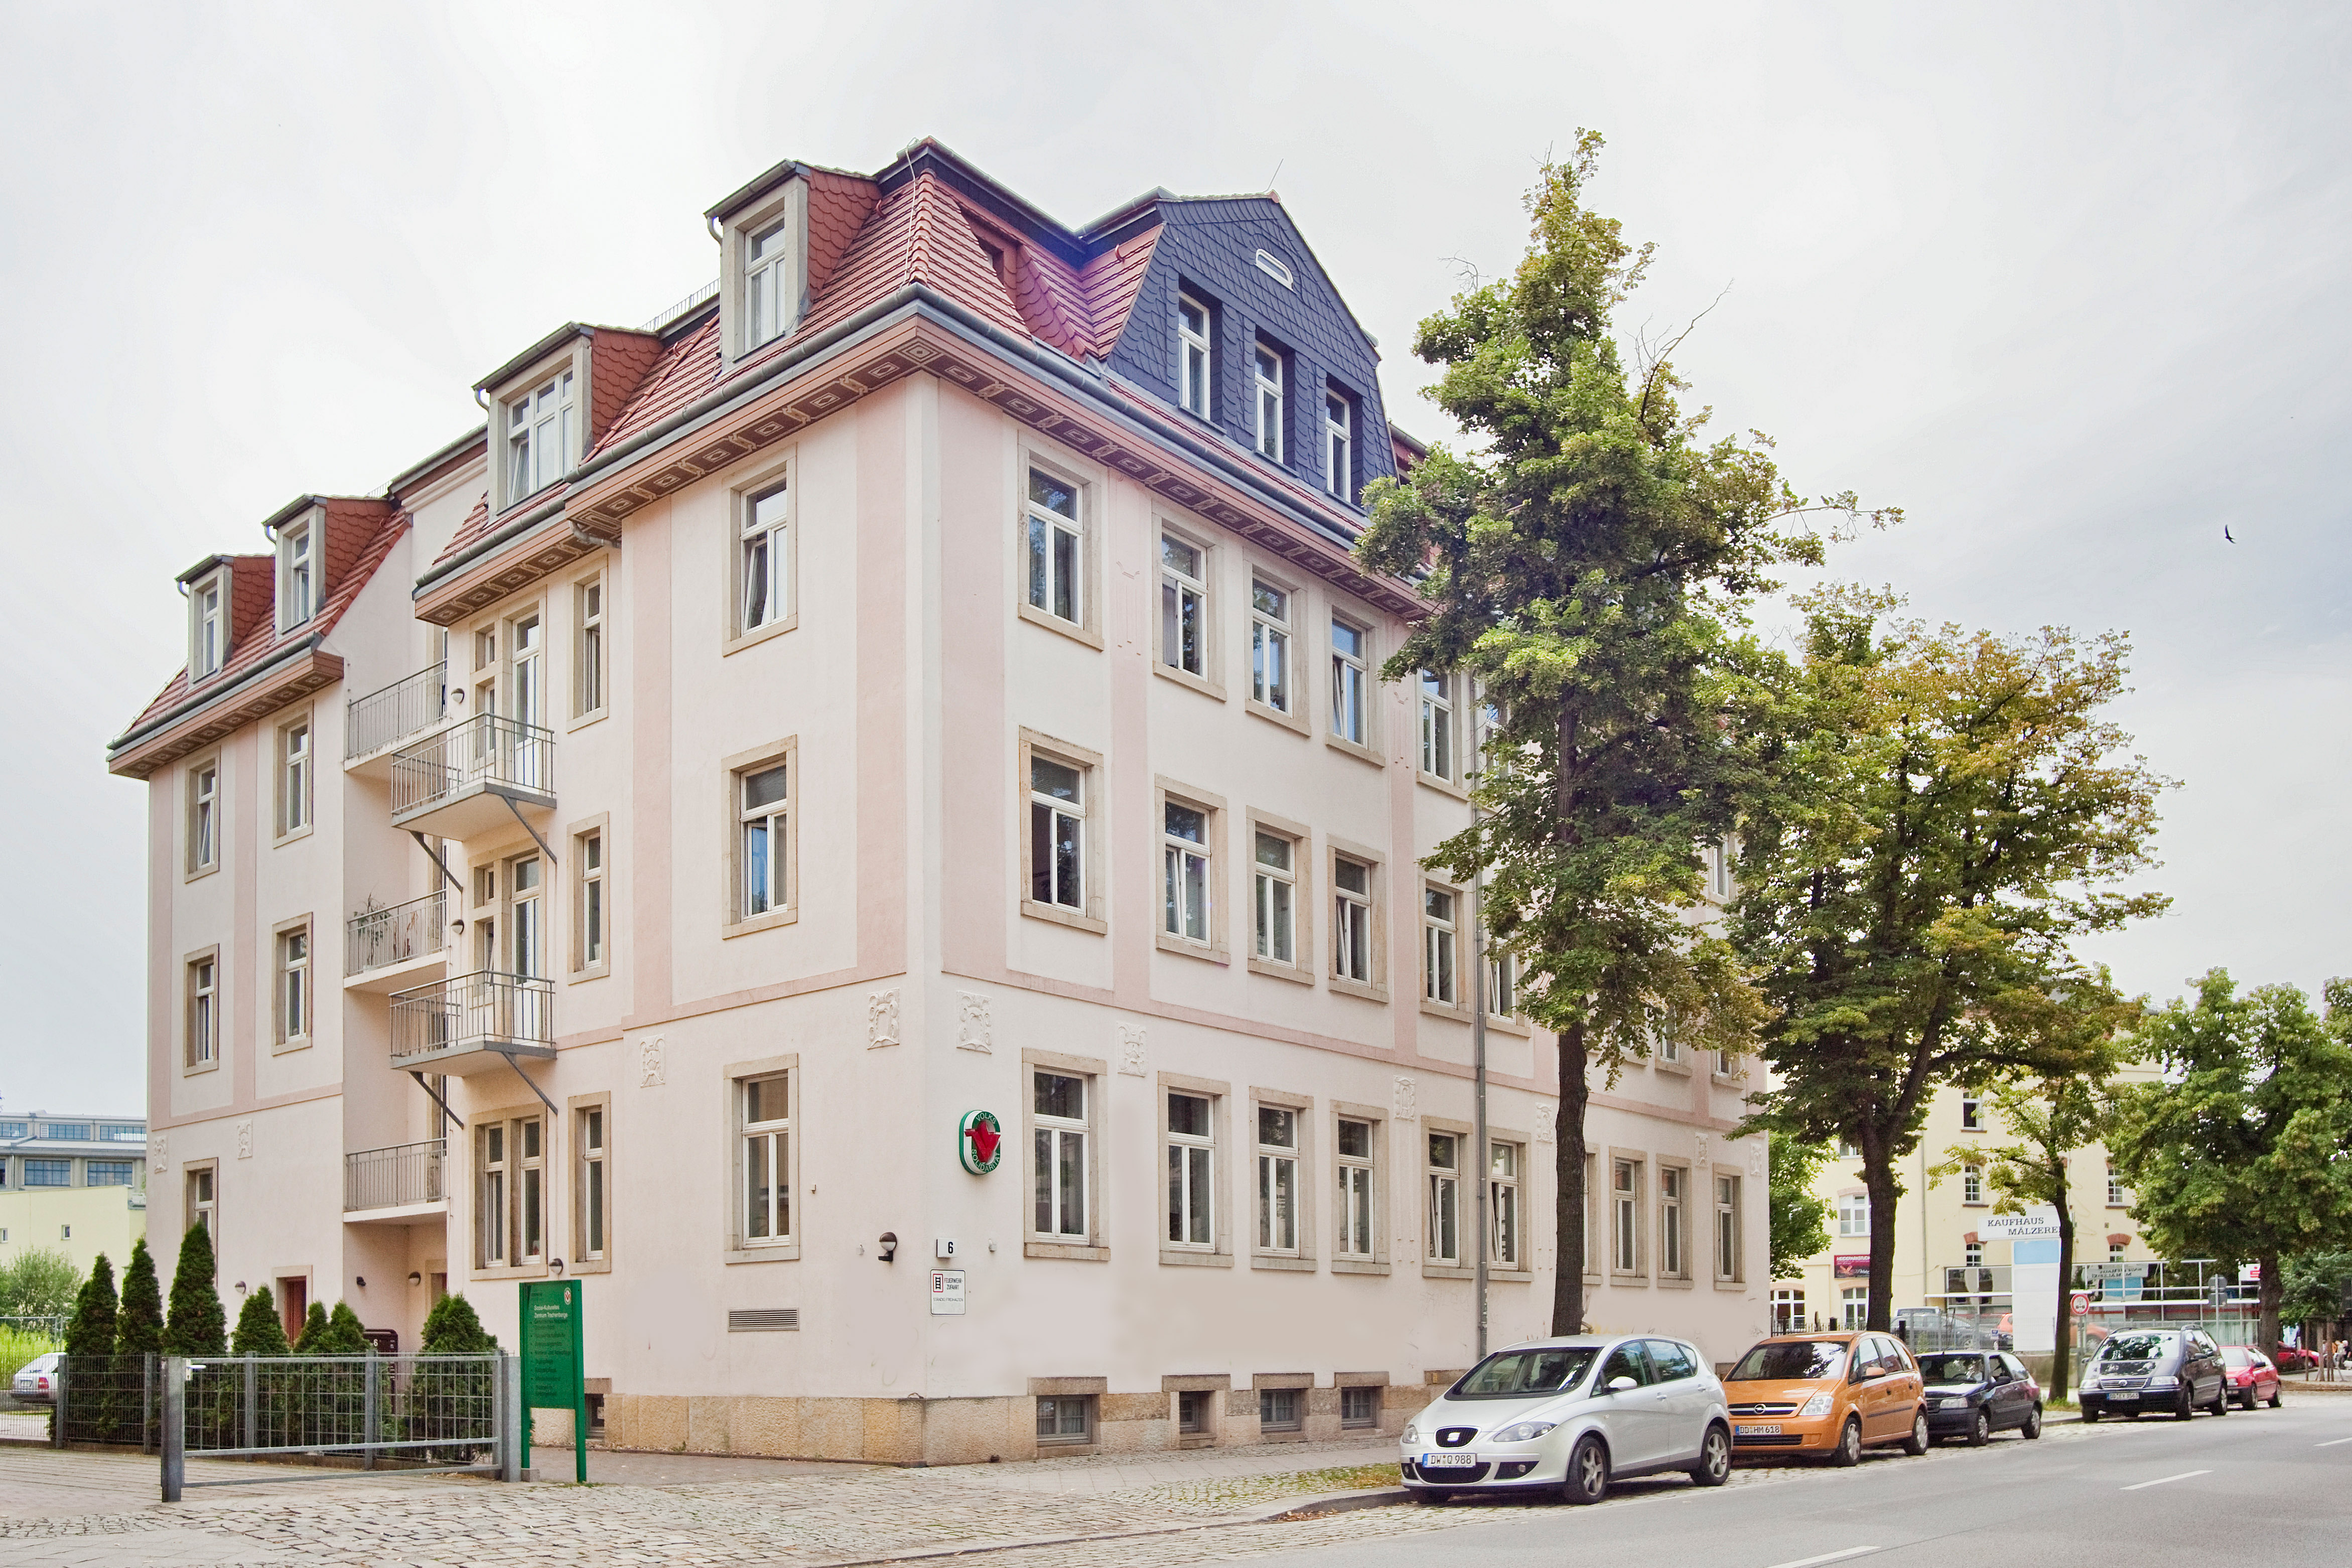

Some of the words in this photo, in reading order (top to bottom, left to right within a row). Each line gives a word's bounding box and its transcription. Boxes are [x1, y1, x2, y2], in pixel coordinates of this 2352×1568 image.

[976, 1112, 997, 1124] VOLKS
[1988, 1217, 2044, 1227] KAUFHAUS
[948, 1242, 953, 1253] 6
[373, 1339, 378, 1347] 6
[1431, 1455, 1441, 1464] DW
[1447, 1455, 1453, 1464] Q
[1455, 1455, 1471, 1464] 988
